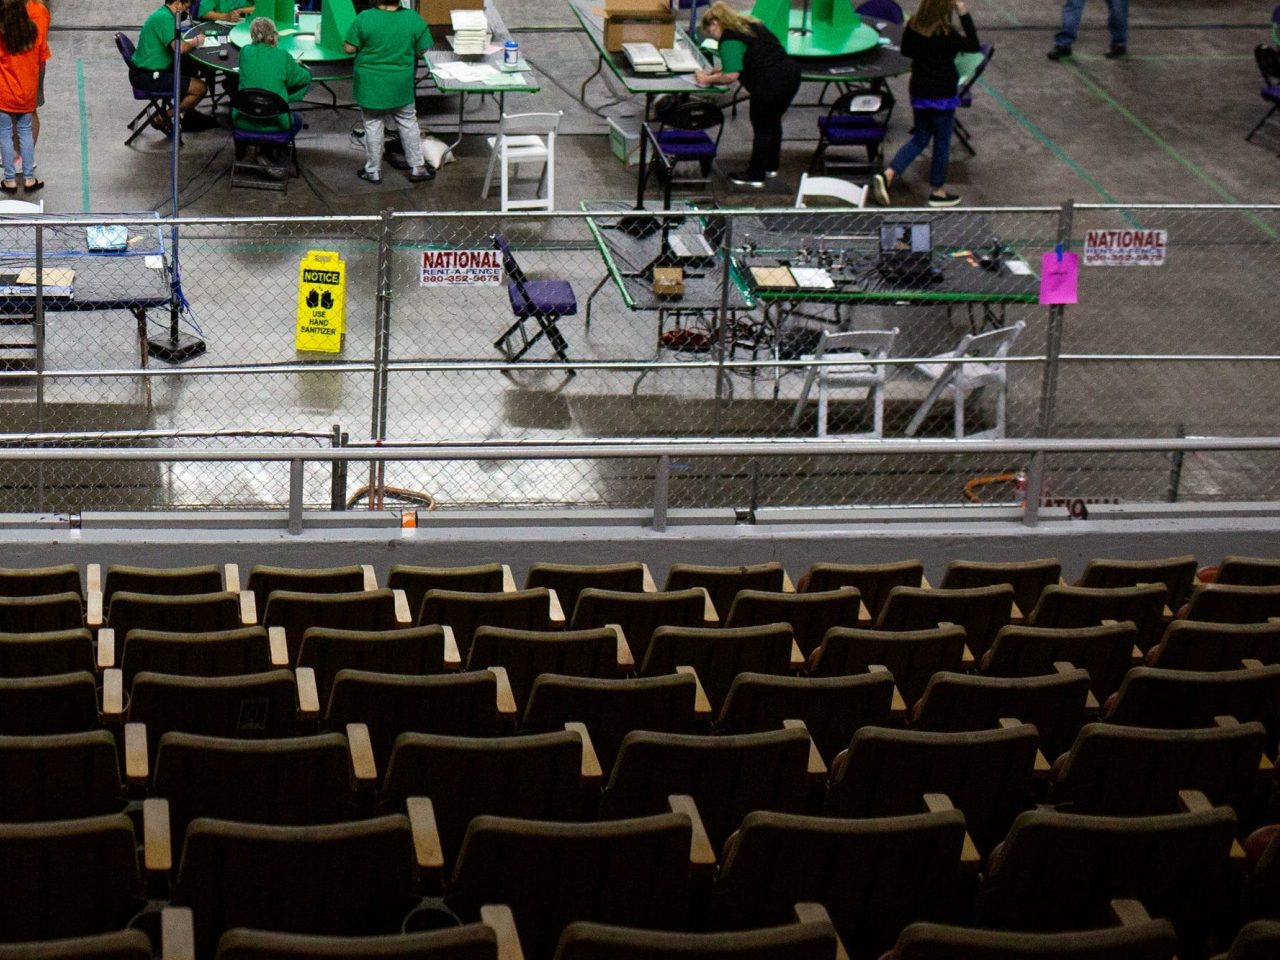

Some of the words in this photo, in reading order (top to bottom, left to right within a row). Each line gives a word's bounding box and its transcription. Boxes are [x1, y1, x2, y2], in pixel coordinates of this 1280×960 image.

[1087, 231, 1164, 248] NATIONAL
[423, 251, 501, 269] NATIONAL
[304, 271, 338, 283] NOTICE
[423, 275, 500, 283] 800-352-5675
[312, 310, 326, 319] USE
[309, 318, 329, 327] HAND
[300, 326, 336, 336] SANITIZER
